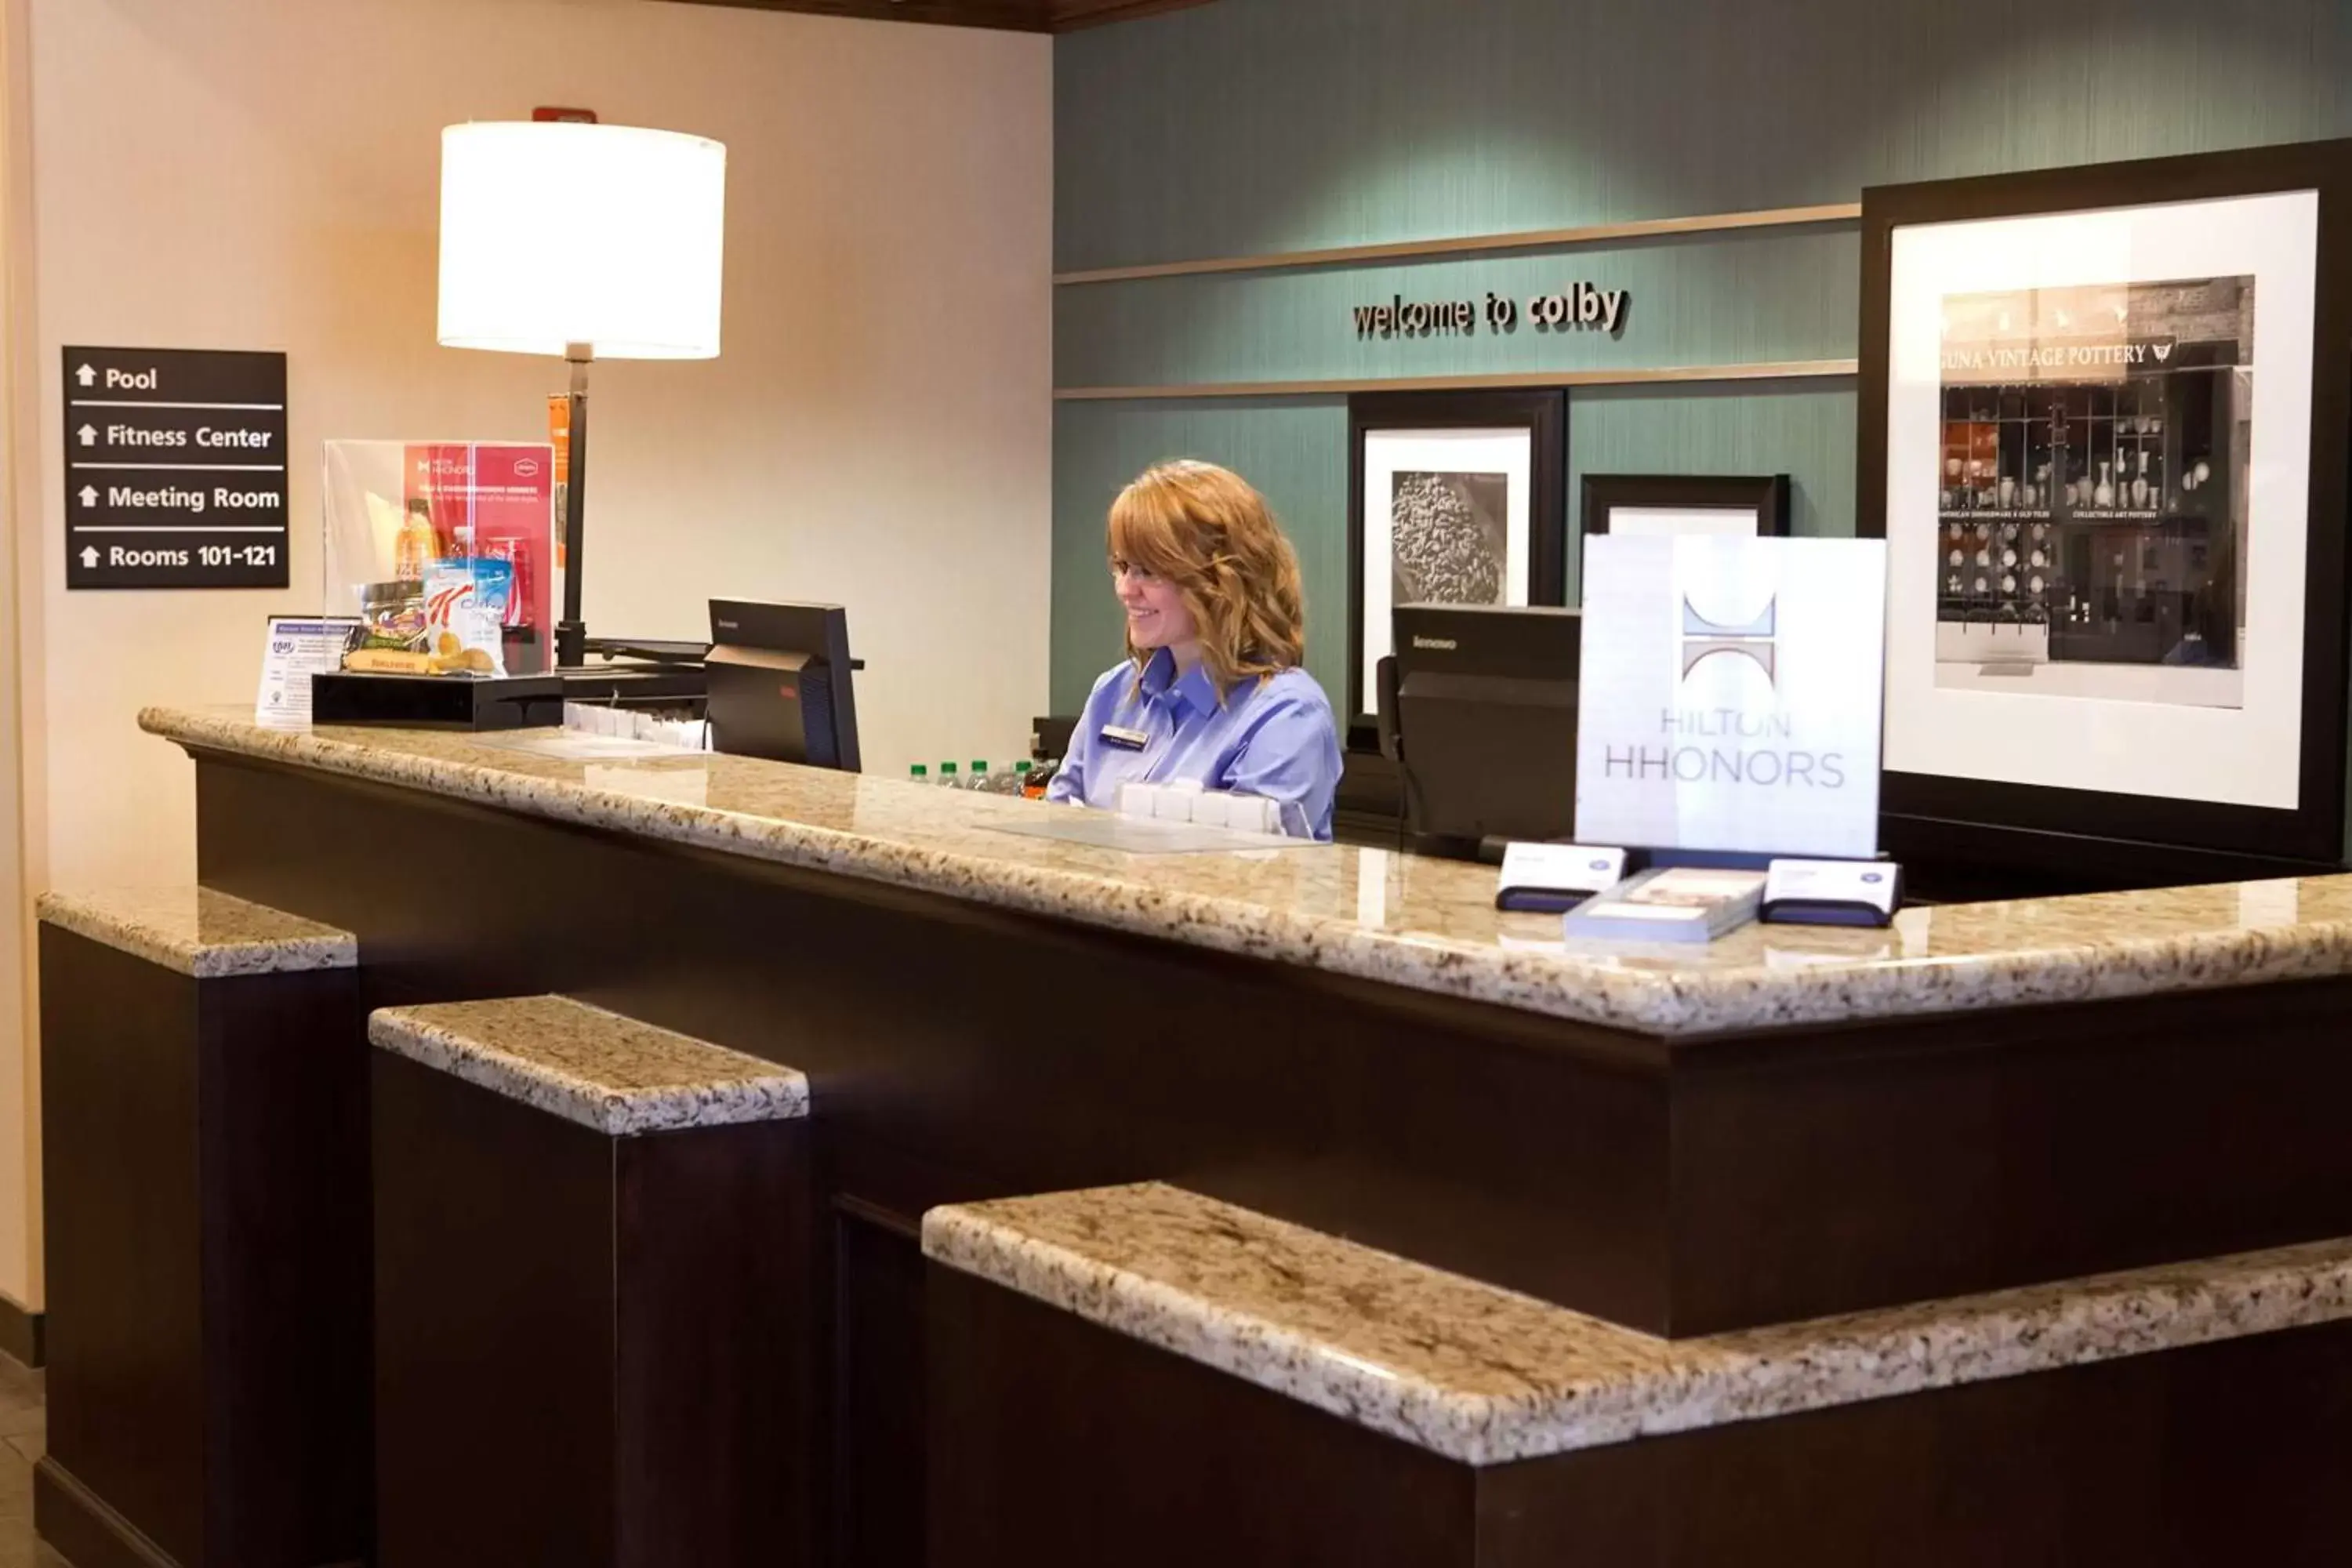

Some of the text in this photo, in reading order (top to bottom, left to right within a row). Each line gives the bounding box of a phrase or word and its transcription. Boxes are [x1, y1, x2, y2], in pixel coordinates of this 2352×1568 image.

[1353, 281, 1624, 334] welcome to colby
[1987, 347, 2064, 367] VINTAGE
[2069, 344, 2147, 365] POTTERY
[106, 367, 157, 390] Pool
[107, 425, 272, 448] Fitness Center
[108, 486, 280, 512] Meeting Room
[110, 546, 275, 566] Rooms 101-121
[1413, 635, 1457, 650] lenovo
[1660, 707, 1792, 739] HILTON
[1604, 743, 1846, 789] HHONORS
